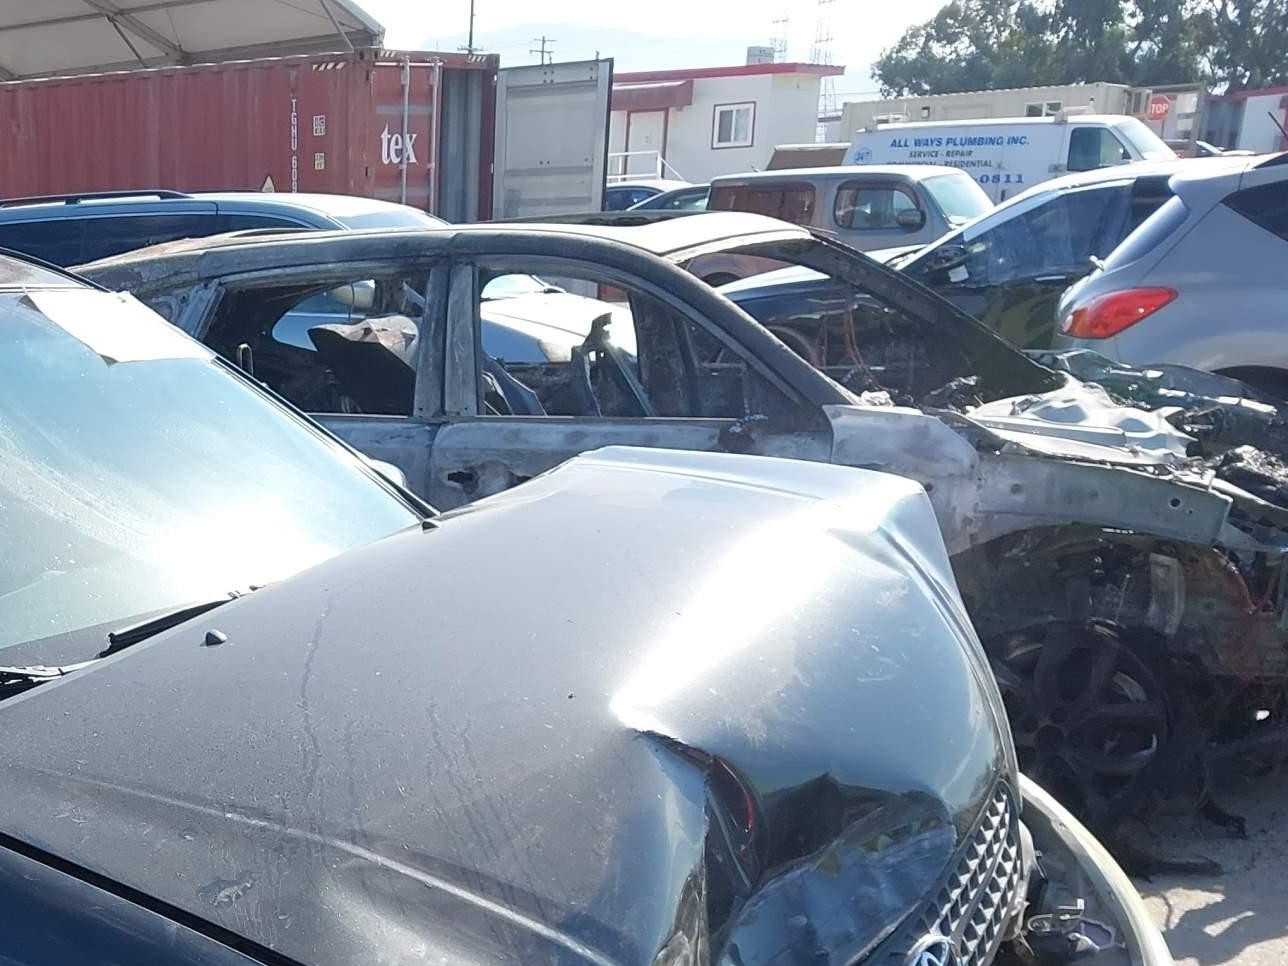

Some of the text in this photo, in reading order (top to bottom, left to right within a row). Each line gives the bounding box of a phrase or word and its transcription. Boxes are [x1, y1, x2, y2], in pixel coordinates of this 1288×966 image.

[1150, 103, 1169, 115] TOP
[380, 123, 418, 165] tex
[890, 135, 1030, 148] ALL WAYS PLUMBING INC.
[908, 150, 939, 158] SERVICE
[946, 150, 973, 158] REPAIR
